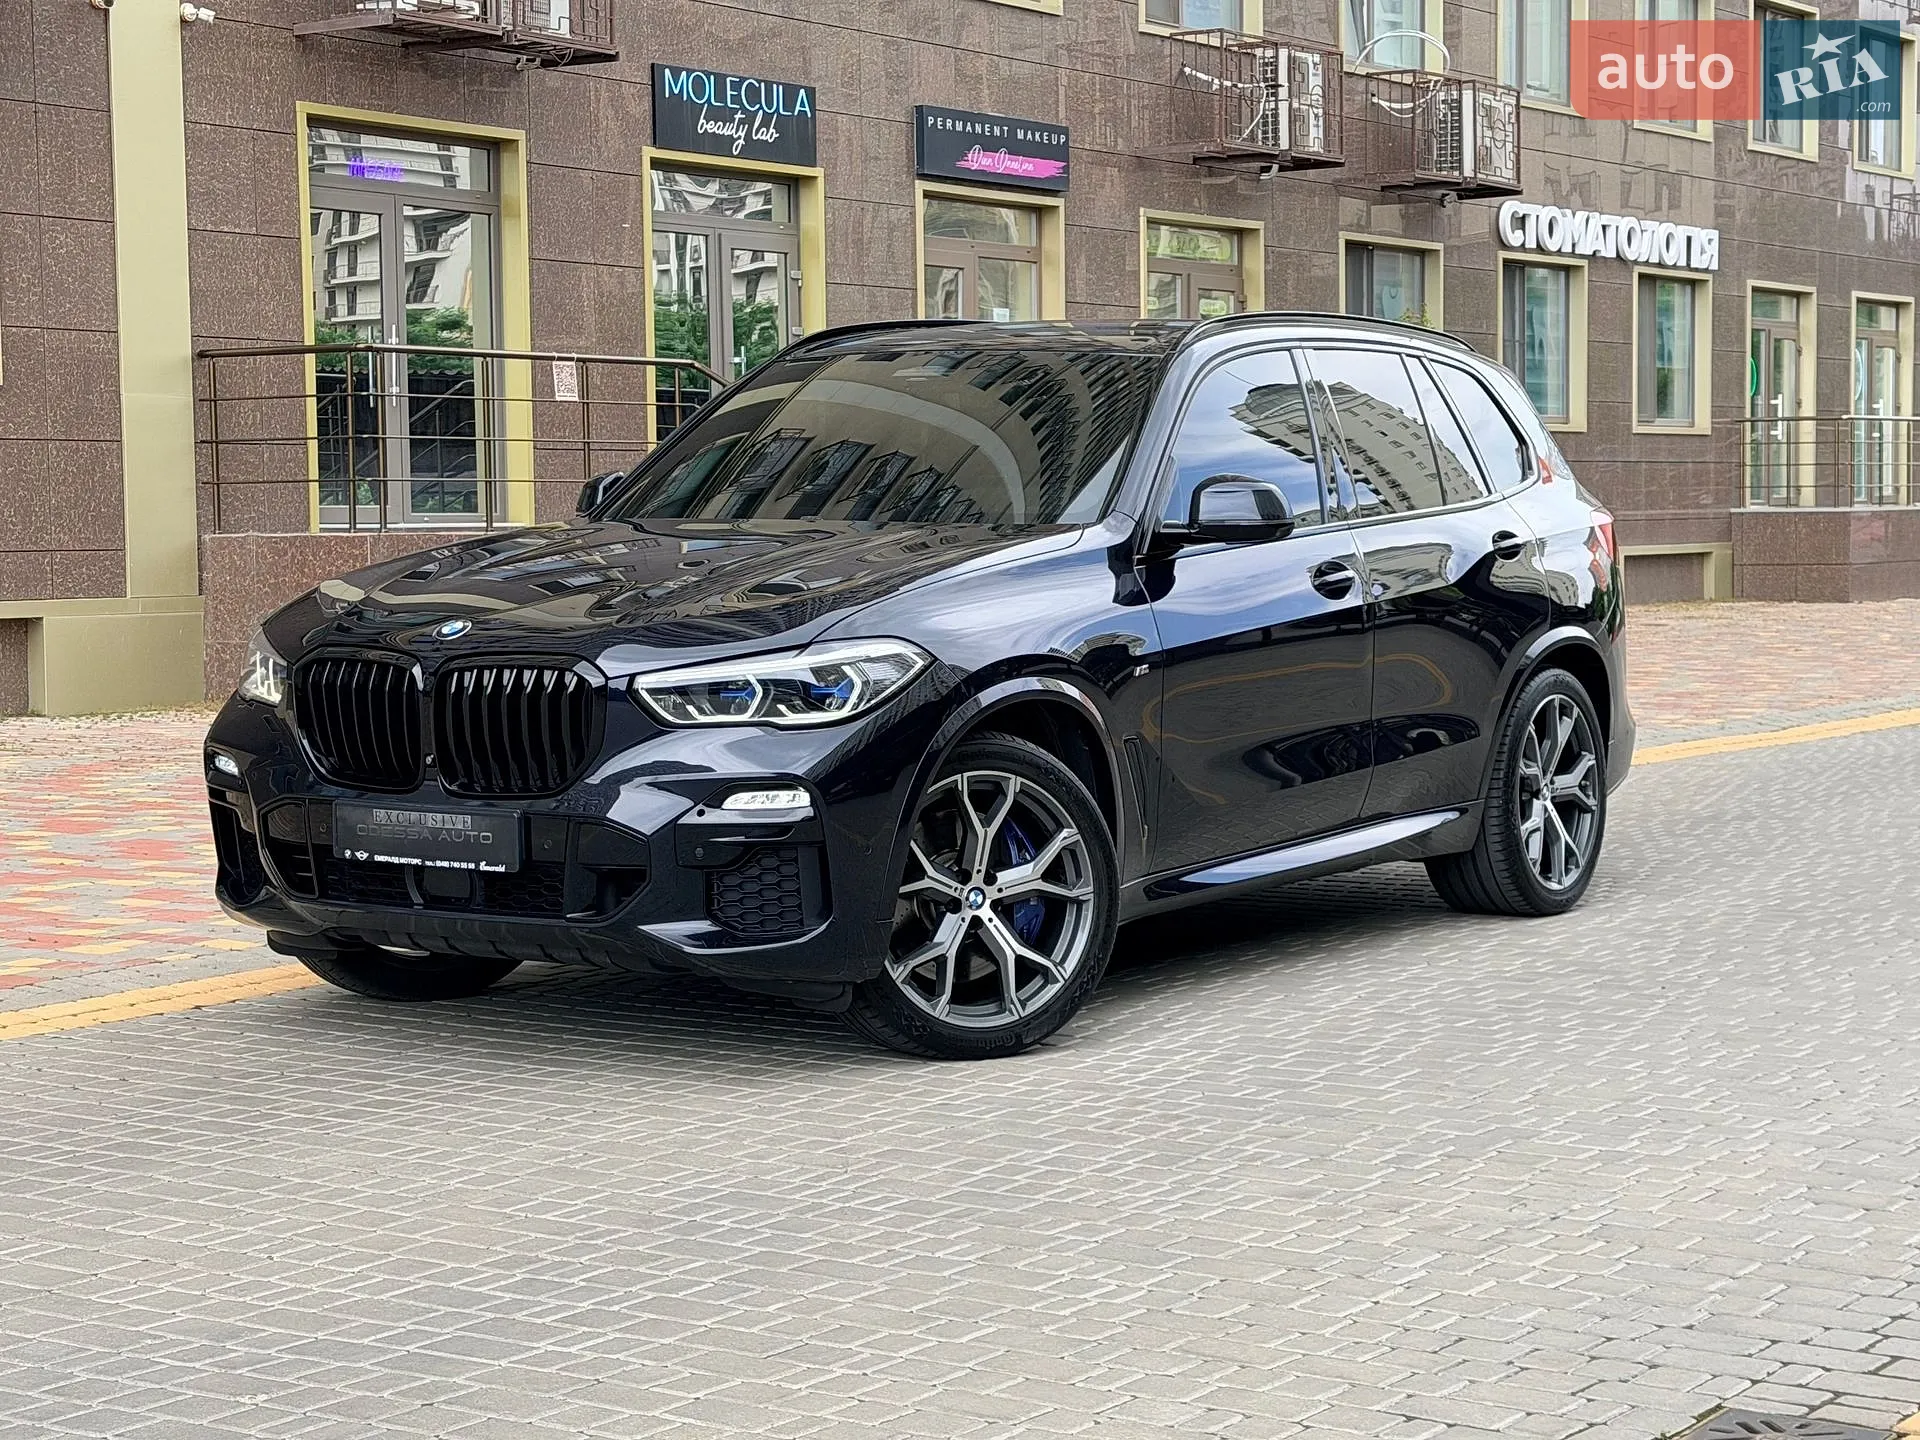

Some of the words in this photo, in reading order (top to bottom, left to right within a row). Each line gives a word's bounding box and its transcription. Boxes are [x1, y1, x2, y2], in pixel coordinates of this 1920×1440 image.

[664, 67, 812, 118] MOLECULA
[697, 104, 749, 156] beauty
[752, 109, 780, 143] lab
[927, 116, 1009, 139] PERMANENT
[1016, 128, 1067, 146] MAKEUP
[1499, 200, 1720, 271] СТОМАТОЛОГІЯ
[356, 824, 432, 841] ODESSA
[438, 830, 493, 844] AUTO
[374, 810, 471, 829] EXCLUSIVE
